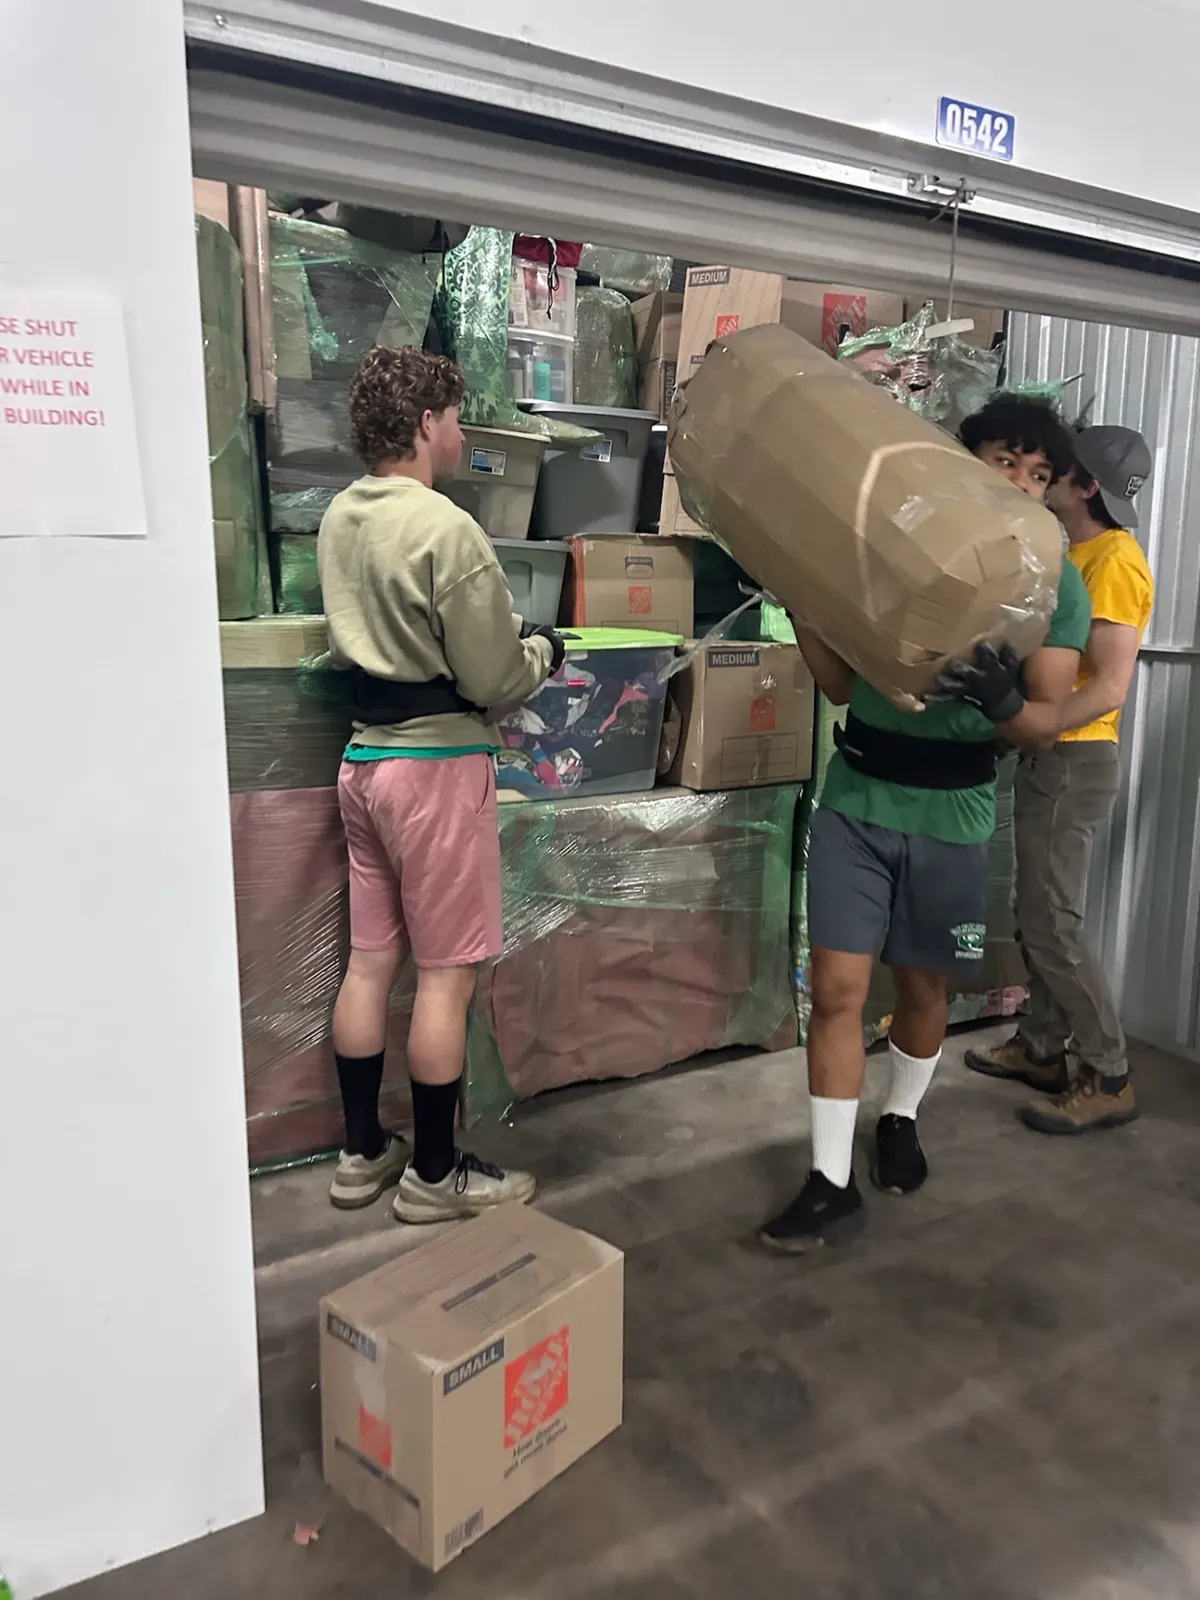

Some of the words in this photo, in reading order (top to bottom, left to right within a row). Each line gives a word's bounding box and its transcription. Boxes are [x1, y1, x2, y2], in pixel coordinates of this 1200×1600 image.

[945, 103, 1009, 154] 0542
[690, 270, 728, 285] MEDIUM
[25, 318, 77, 338] SHUT
[13, 348, 94, 368] VEHICLE
[0, 378, 64, 397] WHILE
[68, 381, 90, 397] IN
[4, 407, 105, 426] BUILDING!
[712, 653, 756, 665] MEDIUM
[449, 1347, 500, 1387] SMALL
